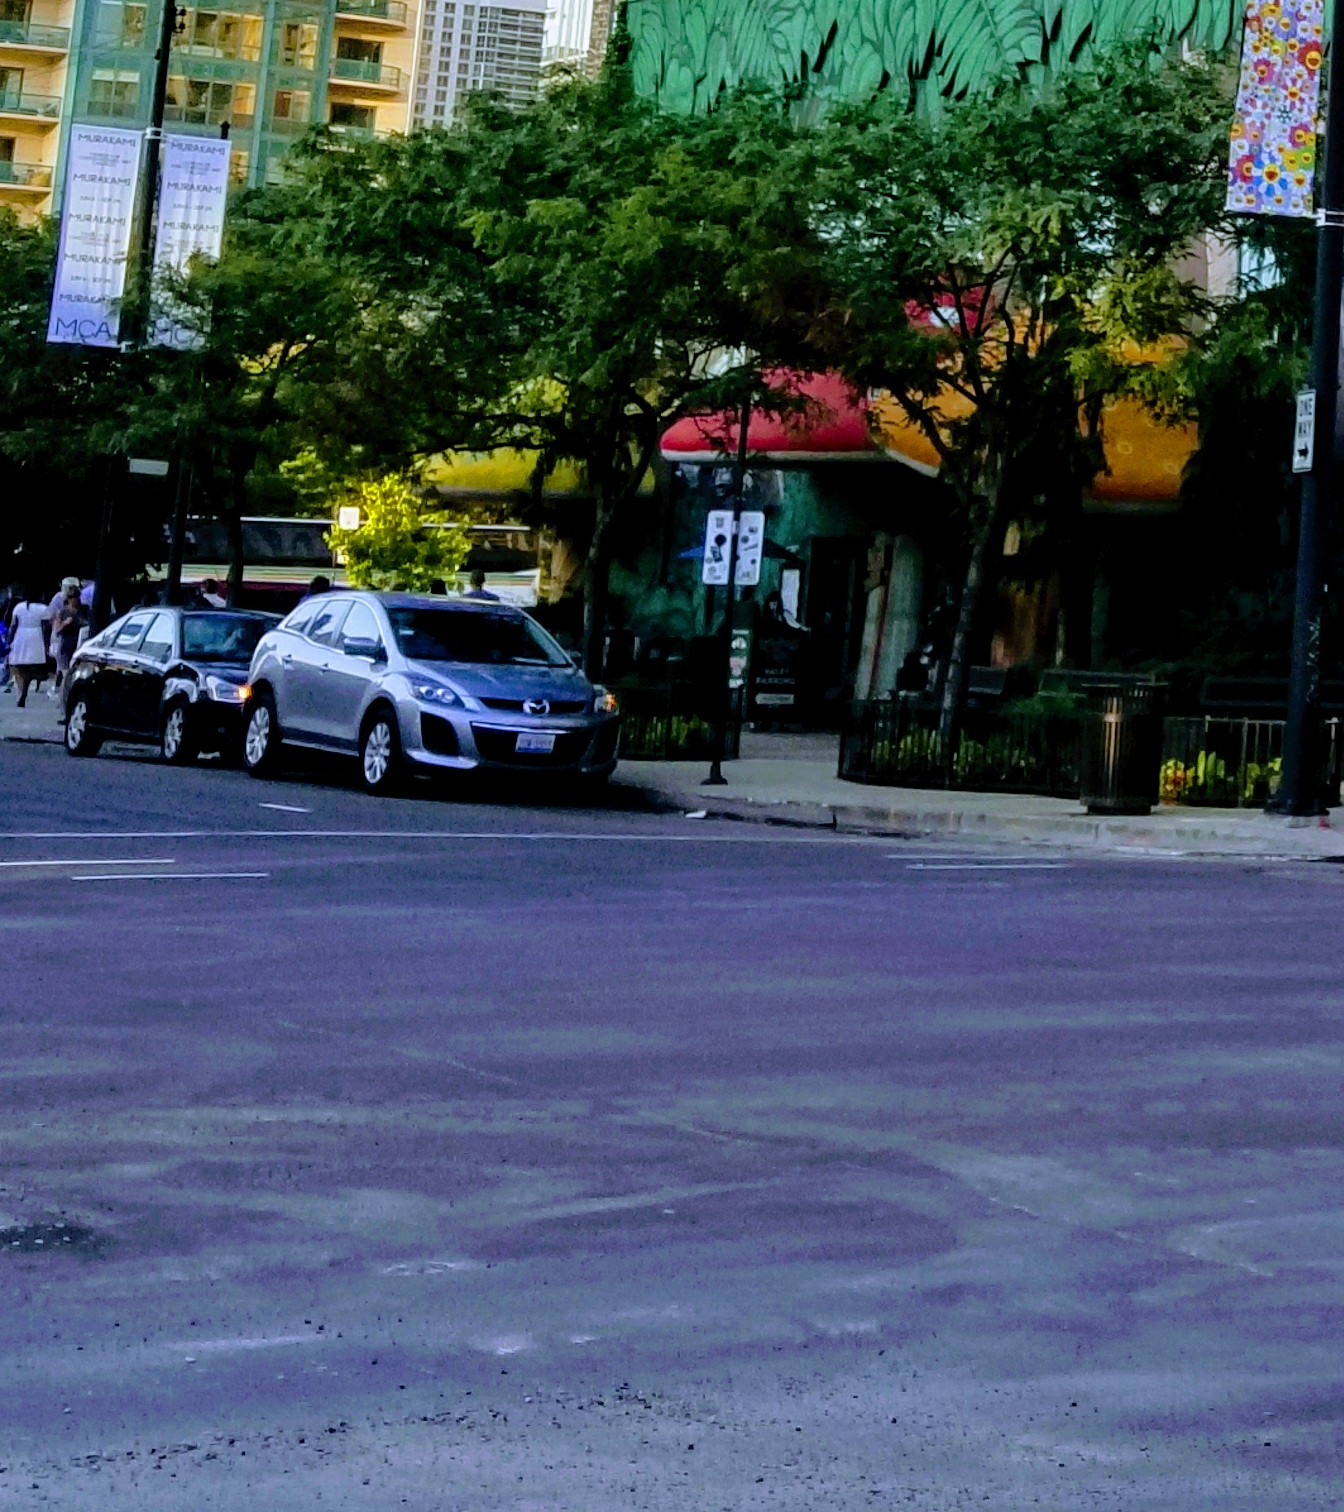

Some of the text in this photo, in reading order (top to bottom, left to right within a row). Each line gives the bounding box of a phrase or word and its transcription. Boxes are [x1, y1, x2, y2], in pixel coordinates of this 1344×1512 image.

[78, 133, 137, 147] MURAKAMI
[170, 142, 226, 156] MURAKAMI
[72, 173, 131, 186] MURAKAMI
[167, 181, 222, 194] MURAKAMI
[68, 212, 126, 226] MURAKAMI
[163, 221, 220, 233] MURAKAMI
[55, 316, 111, 340] MCA
